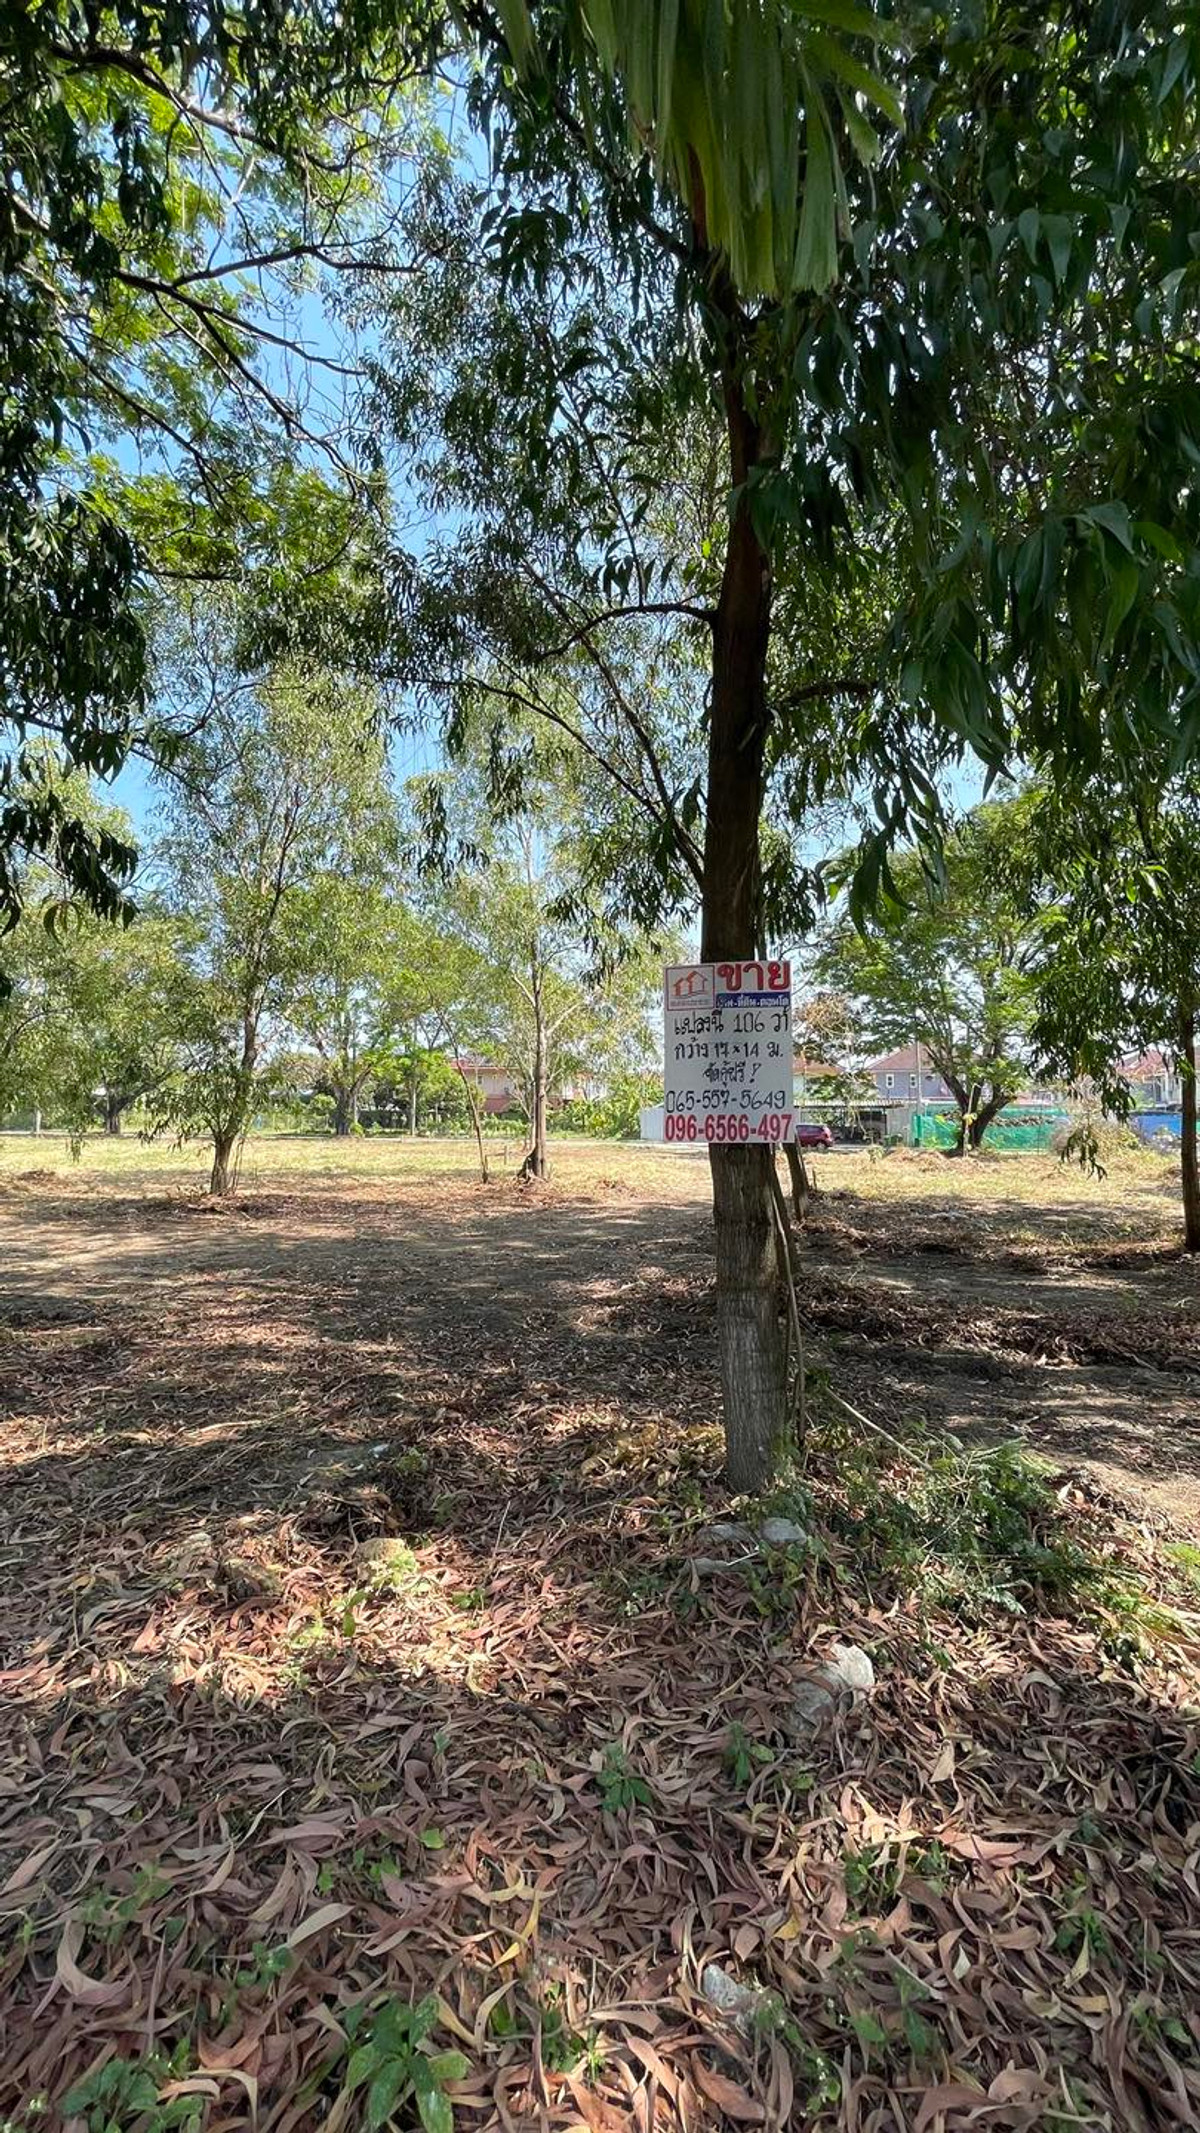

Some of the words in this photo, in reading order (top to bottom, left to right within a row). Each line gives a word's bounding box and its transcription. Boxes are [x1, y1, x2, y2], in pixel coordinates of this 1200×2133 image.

[717, 961, 790, 991] ขาย
[733, 1011, 765, 1033] 106
[674, 1037, 709, 1060] กว้าง
[766, 1041, 784, 1058] ม.
[666, 1089, 786, 1113] 065-557-5649
[665, 1113, 792, 1141] 096-6566-497
